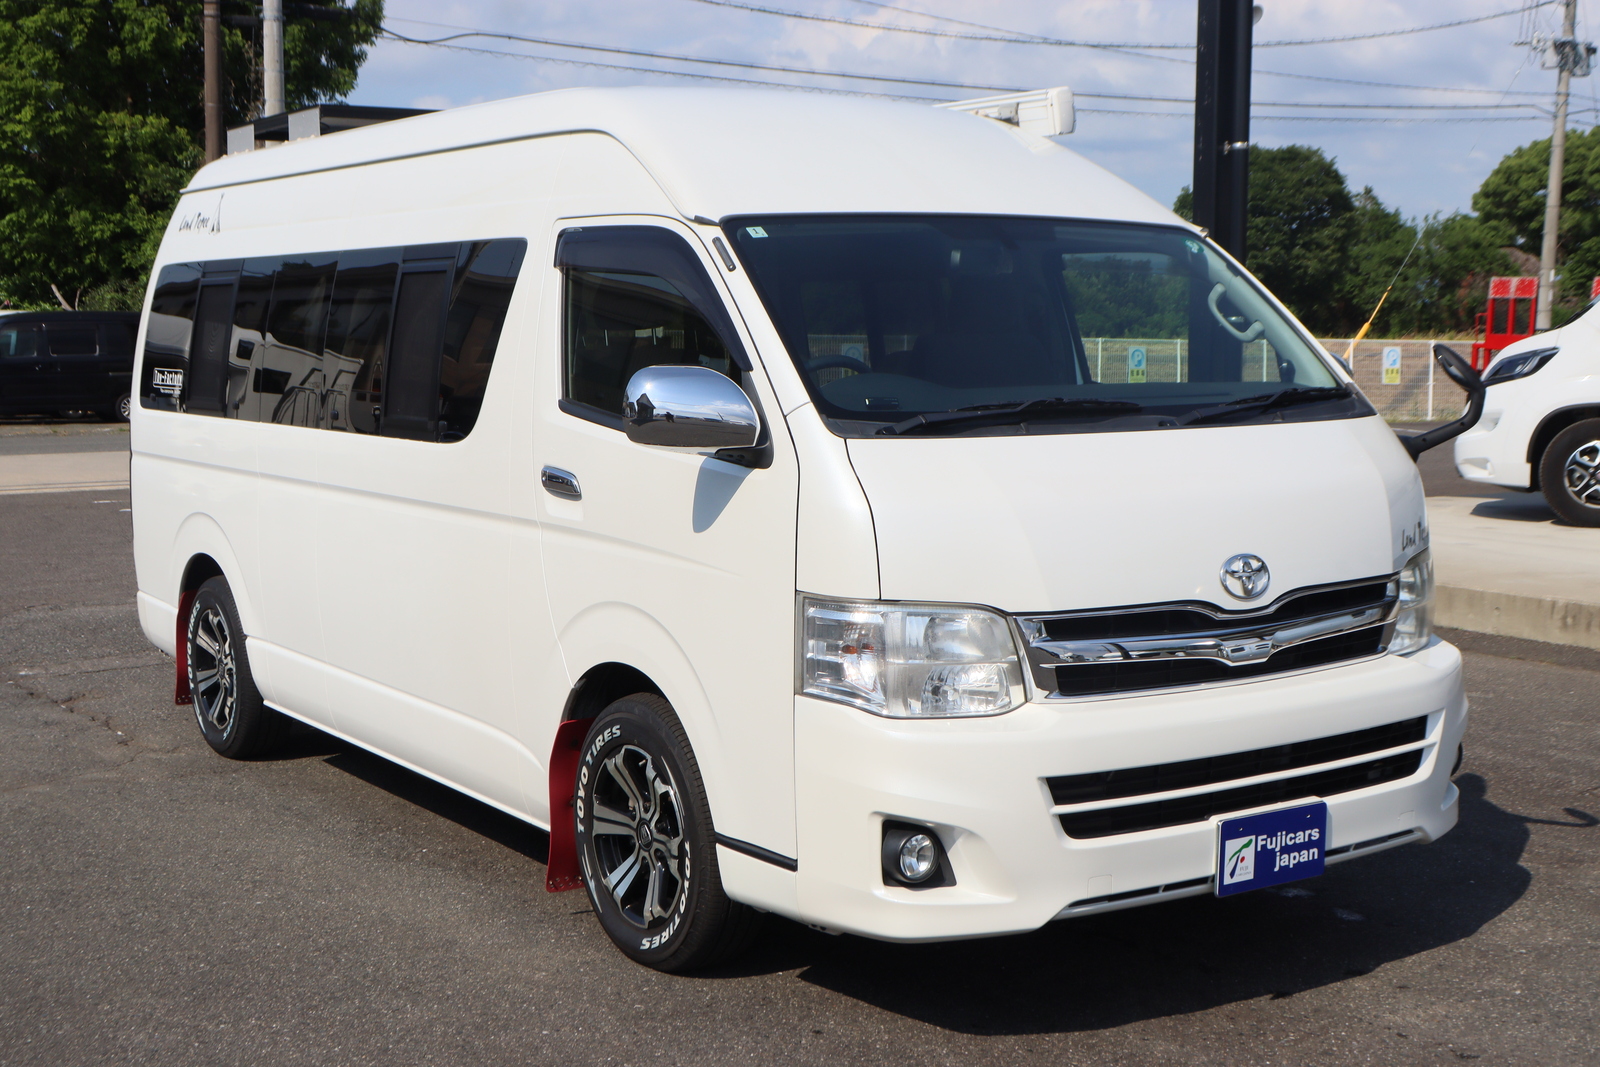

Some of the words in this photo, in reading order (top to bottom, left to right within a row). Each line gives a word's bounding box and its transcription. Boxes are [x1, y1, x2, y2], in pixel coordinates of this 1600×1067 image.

[187, 641, 195, 690] TOYO
[577, 765, 589, 834] TOYO
[585, 724, 621, 767] TIRES
[1257, 828, 1320, 852] Fujicars
[1274, 847, 1318, 872] japan
[680, 841, 691, 914] TOYO
[640, 913, 681, 950] TIRES
